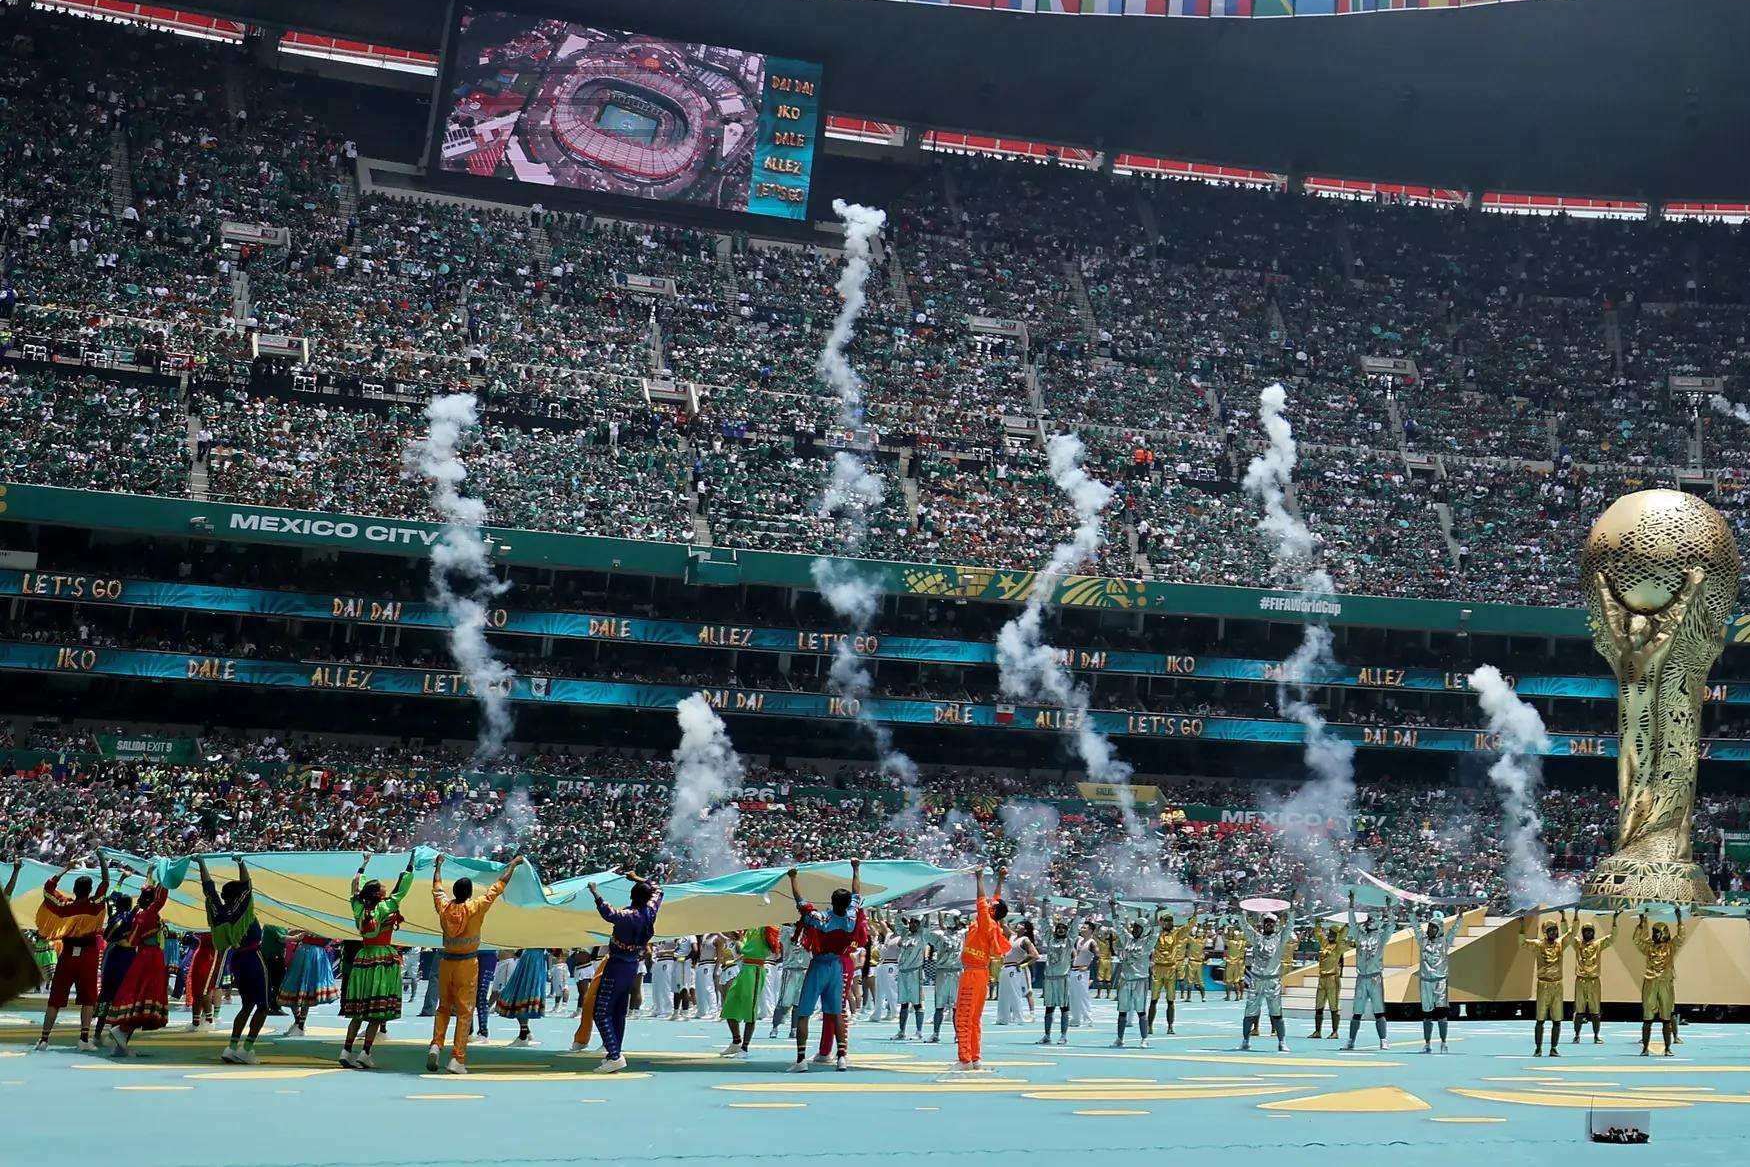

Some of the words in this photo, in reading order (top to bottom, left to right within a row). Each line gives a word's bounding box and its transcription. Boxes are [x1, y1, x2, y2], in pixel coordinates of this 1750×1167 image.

[229, 513, 359, 538] MEXICO
[364, 525, 440, 546] CITY
[21, 573, 87, 597] LET'S
[91, 578, 123, 600] GO
[331, 597, 364, 618] DAI
[370, 602, 402, 622] DAI
[1259, 596, 1342, 616] #FIFAWorldCup
[589, 618, 632, 638] DALE
[698, 625, 753, 647] ALLEZ
[853, 636, 878, 655] GO
[56, 647, 97, 671] IKO
[186, 658, 237, 680] DALE
[1080, 651, 1107, 670] DAI
[1166, 655, 1196, 675] IKO
[310, 667, 373, 691] ALLEZ
[1358, 667, 1405, 687] ALLEZ
[736, 692, 765, 711] DAI
[1704, 684, 1728, 702] DAI
[829, 697, 861, 716] IKO
[934, 703, 974, 725] DALE
[1127, 715, 1176, 735] LET'S
[1180, 718, 1203, 736] GO
[116, 740, 146, 751] SALIDA
[147, 741, 166, 752] EXIT
[166, 742, 173, 753] 9
[1363, 727, 1388, 745] DAI
[1392, 729, 1418, 747] DAI
[1569, 739, 1605, 755] DALE
